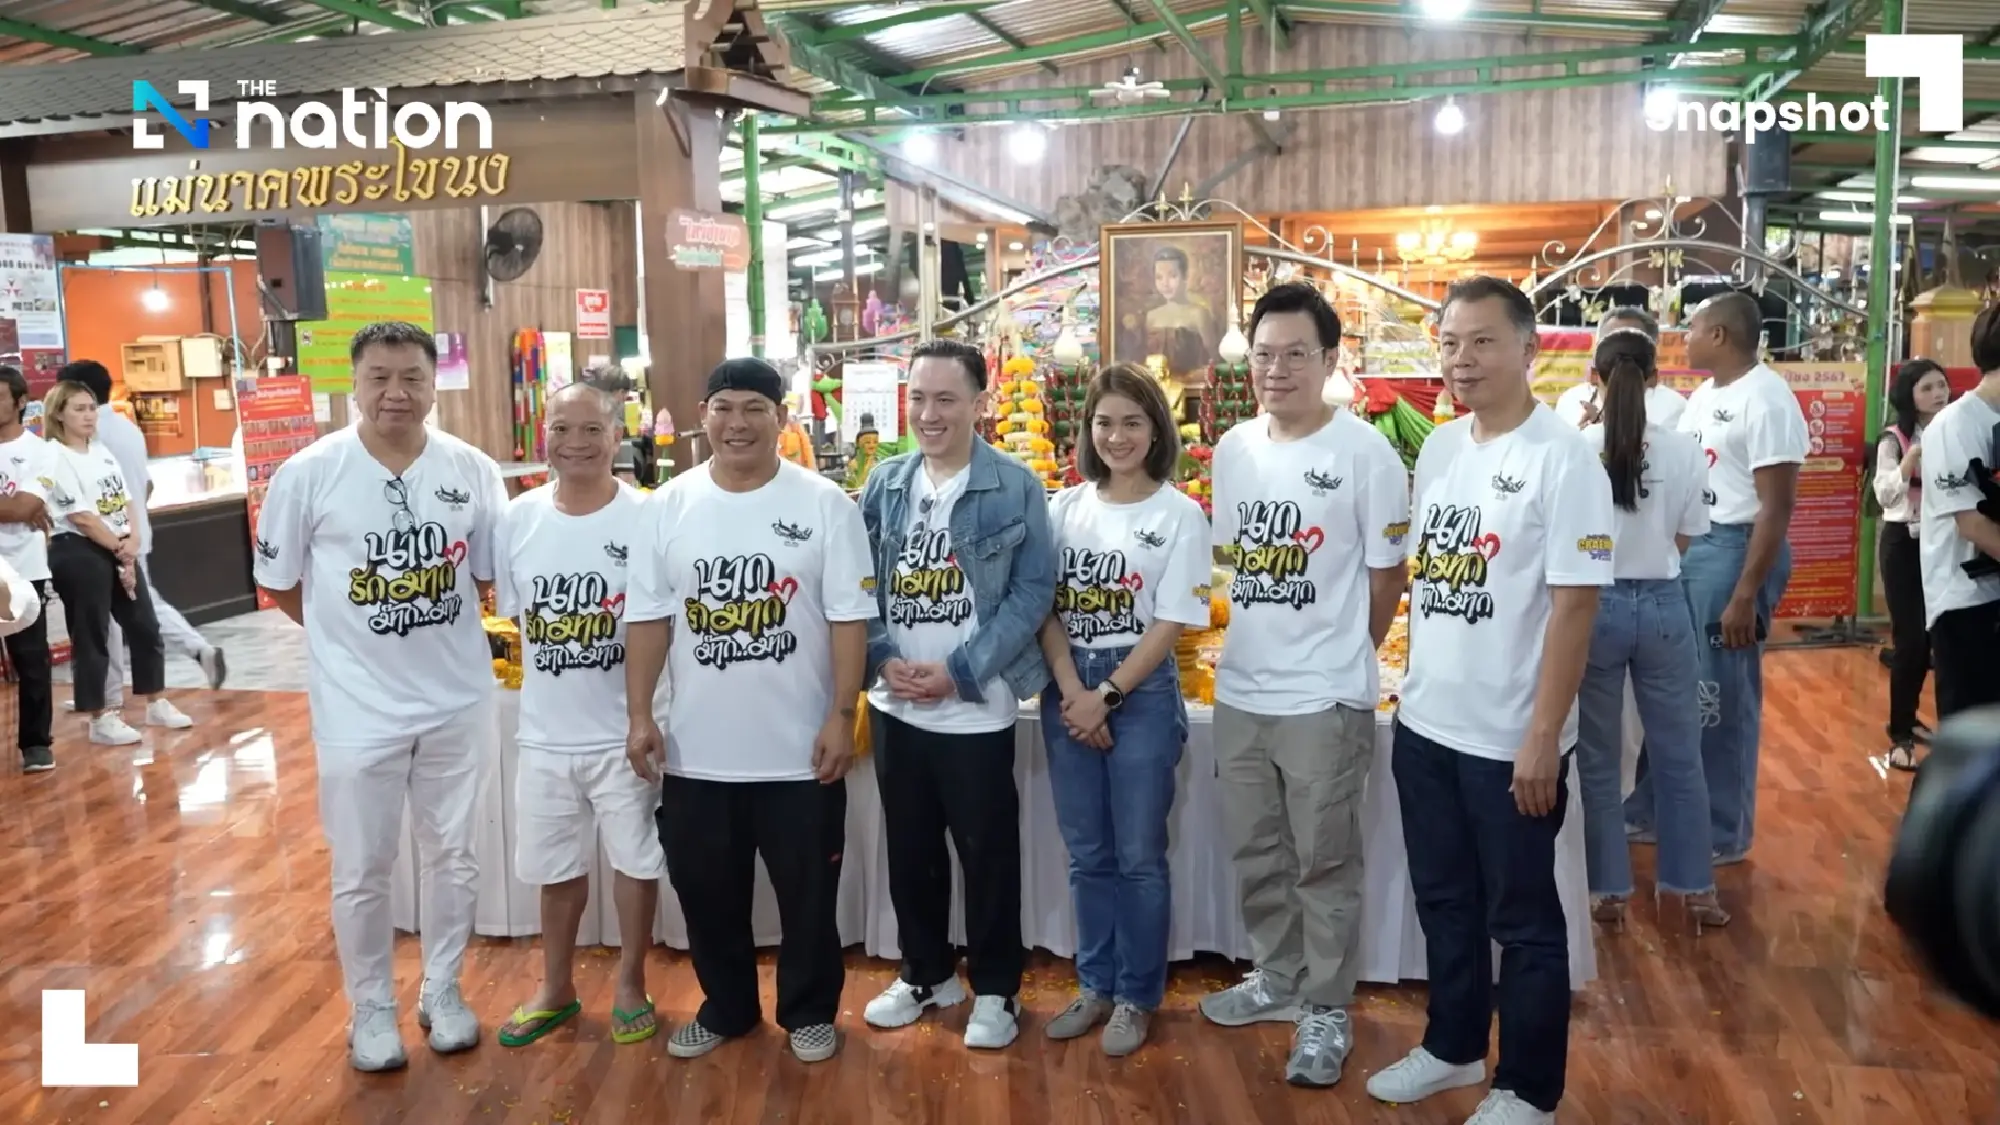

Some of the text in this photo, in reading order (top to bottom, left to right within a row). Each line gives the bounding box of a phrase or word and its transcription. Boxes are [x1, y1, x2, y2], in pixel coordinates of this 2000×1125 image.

[130, 136, 510, 217] แม่นาคพระโขนง
[1814, 371, 1846, 382] 2567
